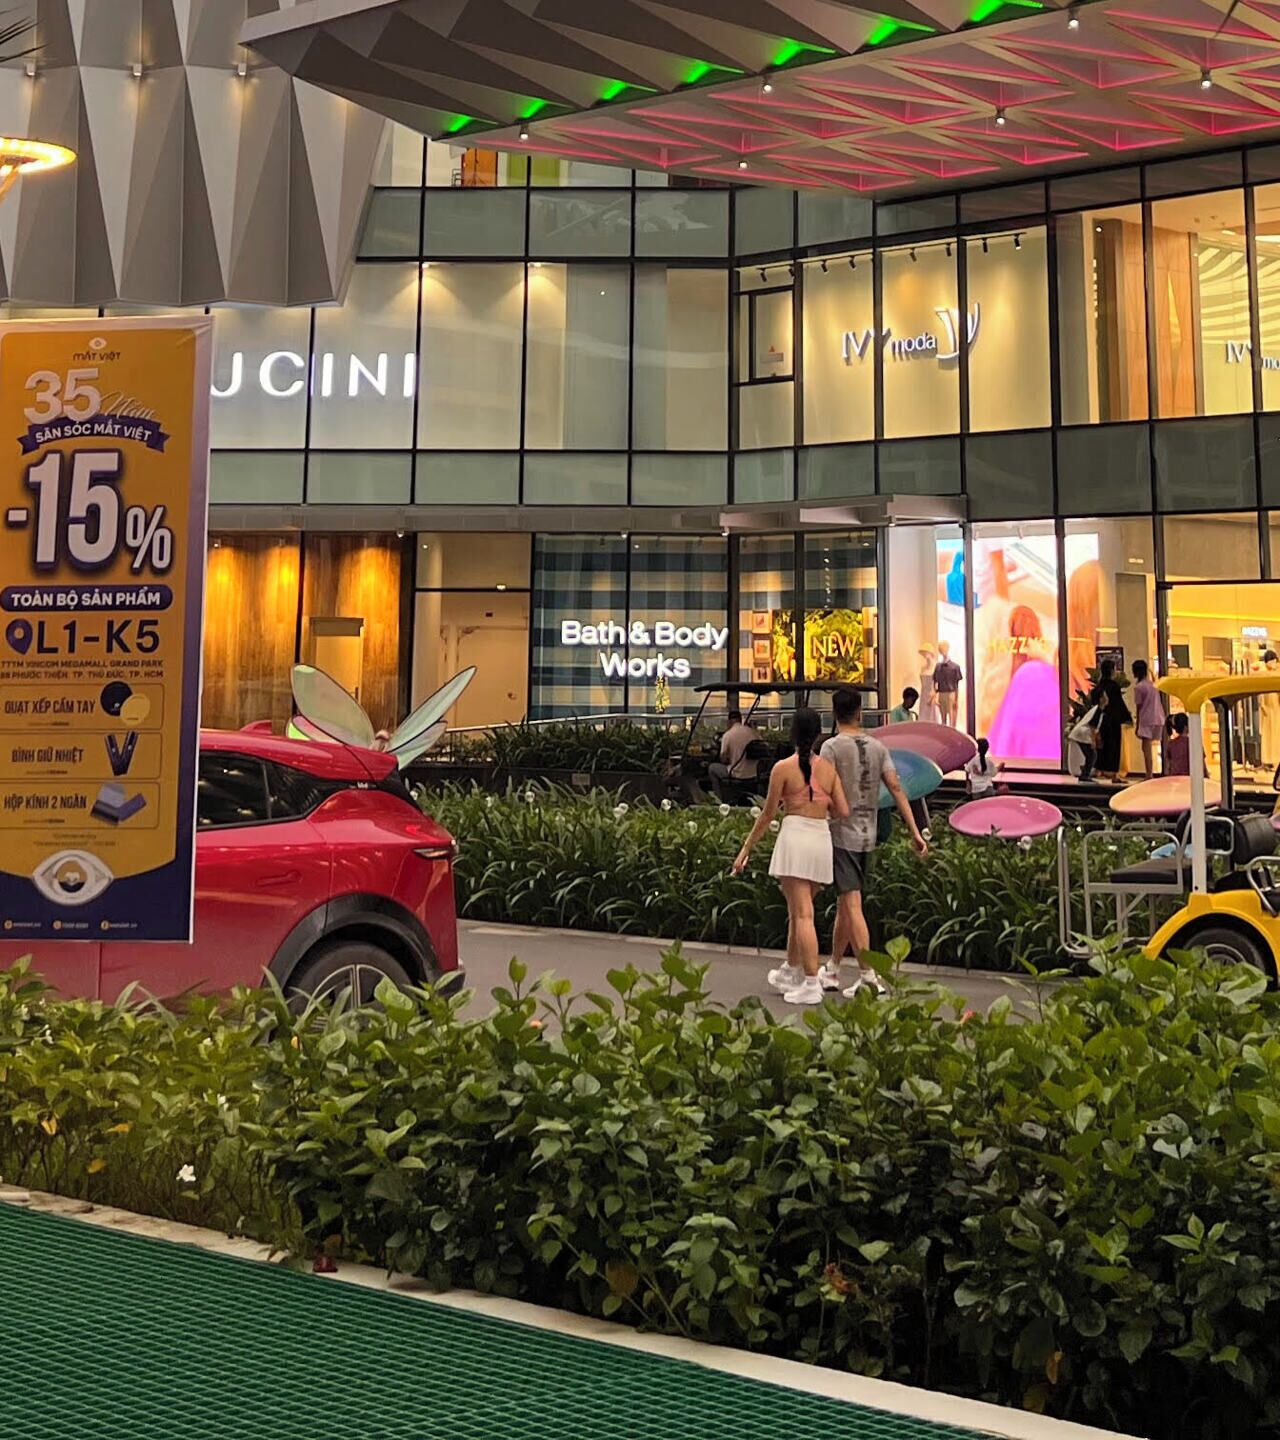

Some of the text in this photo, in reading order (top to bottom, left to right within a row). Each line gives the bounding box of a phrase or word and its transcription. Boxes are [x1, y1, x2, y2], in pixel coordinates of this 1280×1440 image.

[891, 334, 936, 353] moda
[23, 367, 101, 424] 35
[36, 618, 160, 655] L1-K5
[560, 620, 729, 651] Bath & Body
[812, 631, 858, 657] NEW
[600, 652, 691, 679] Works
[51, 796, 57, 809] 2
